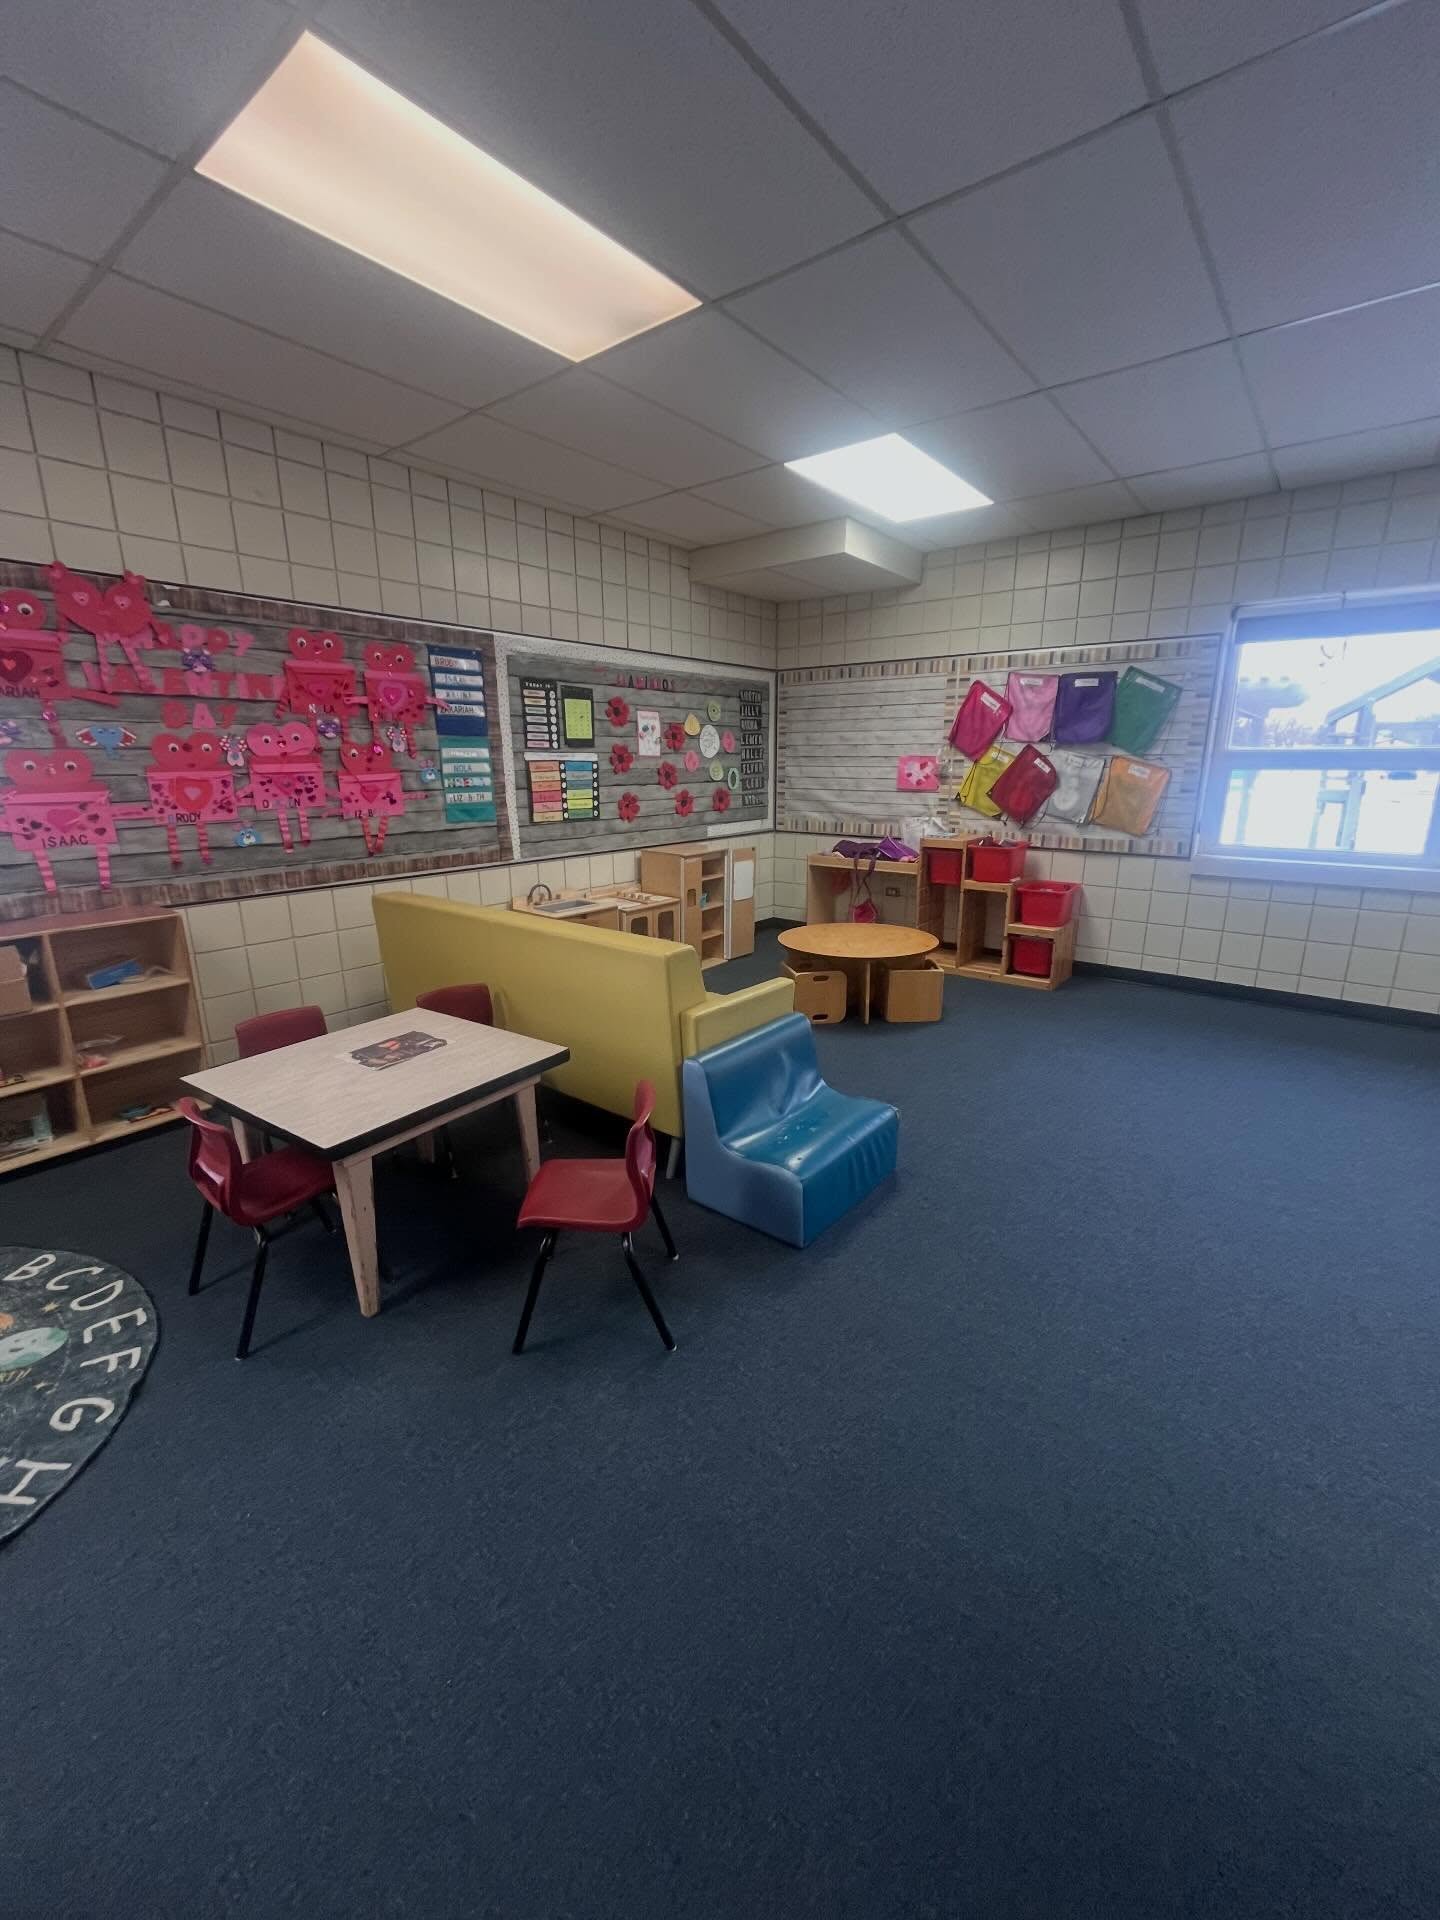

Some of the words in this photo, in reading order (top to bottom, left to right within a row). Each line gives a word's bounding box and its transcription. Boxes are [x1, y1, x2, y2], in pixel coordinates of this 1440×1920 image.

[41, 834, 89, 848] ISAAC
[3, 1254, 56, 1281] B
[46, 1266, 105, 1291] C
[69, 1279, 124, 1311] D
[83, 1308, 147, 1344] E
[80, 1346, 142, 1373] F
[49, 1397, 115, 1432] G
[0, 1459, 72, 1505] H
